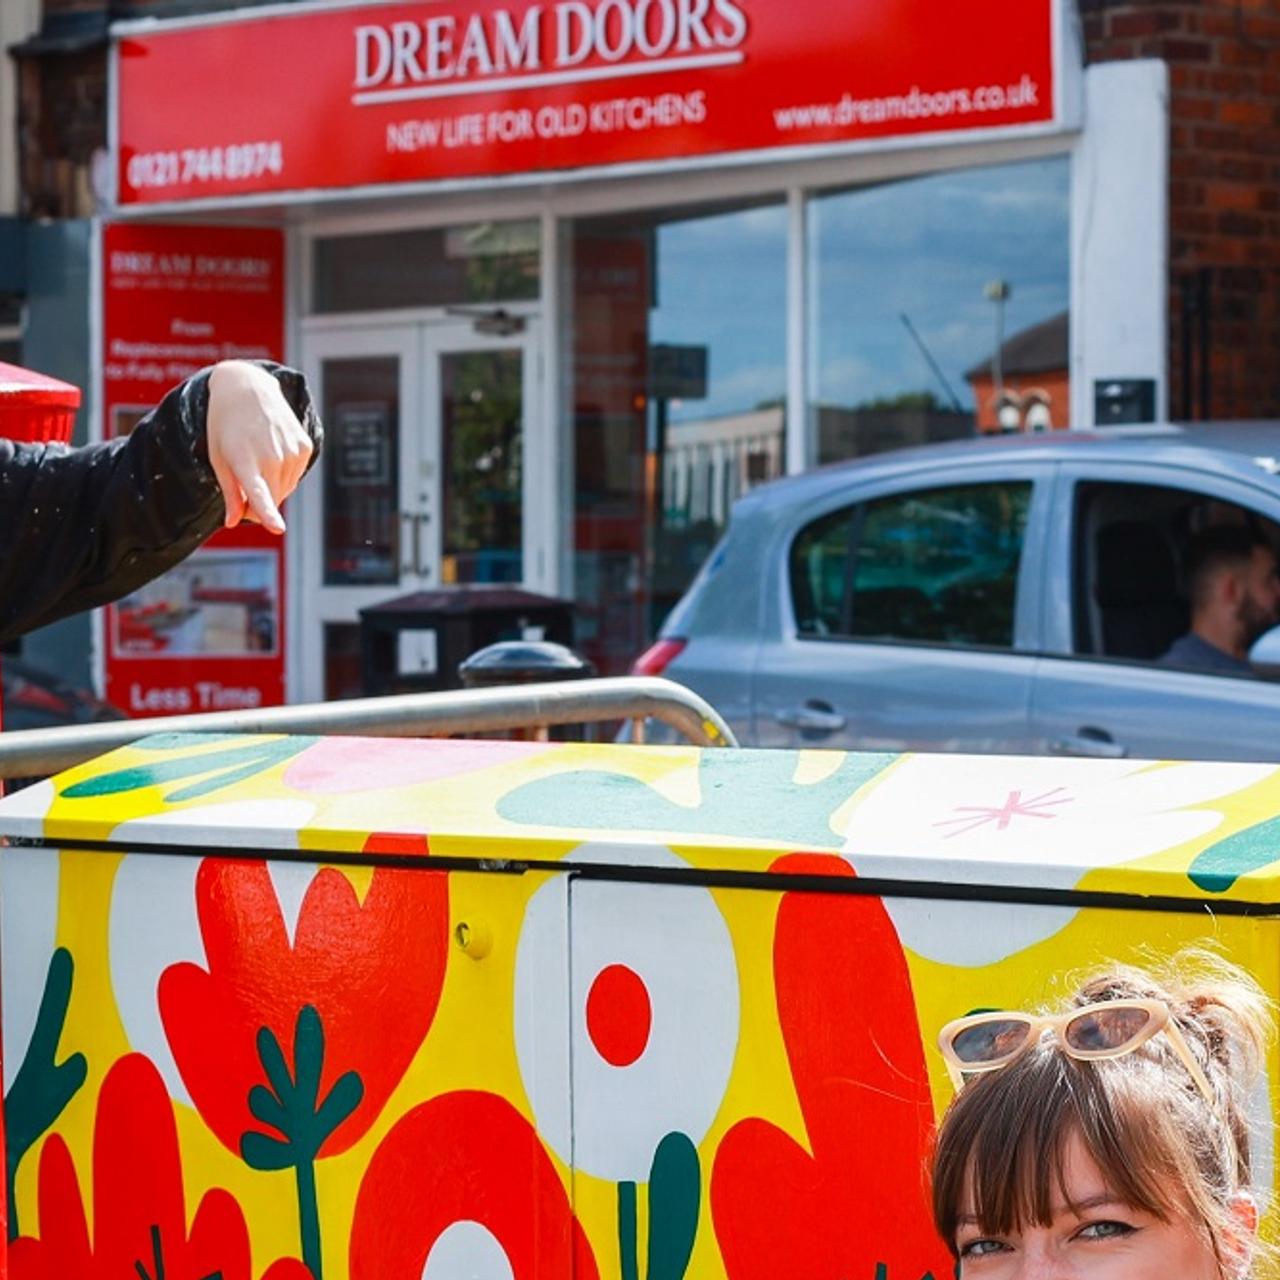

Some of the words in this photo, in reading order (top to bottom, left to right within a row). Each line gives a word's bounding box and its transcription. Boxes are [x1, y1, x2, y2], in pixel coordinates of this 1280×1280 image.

[353, 4, 541, 88] DREAM
[555, 0, 748, 67] DOORS
[386, 120, 439, 153] NEW
[441, 112, 485, 148] LIFE
[486, 107, 535, 143] FOR
[536, 103, 587, 139] OLD
[589, 91, 706, 133] KITCHENS
[773, 73, 1040, 130] www.dreamdoors.co.uk
[127, 152, 179, 189] 0121
[181, 146, 223, 184] 744
[225, 140, 283, 181] 8974
[130, 682, 191, 710] Less
[194, 681, 262, 709] Time
